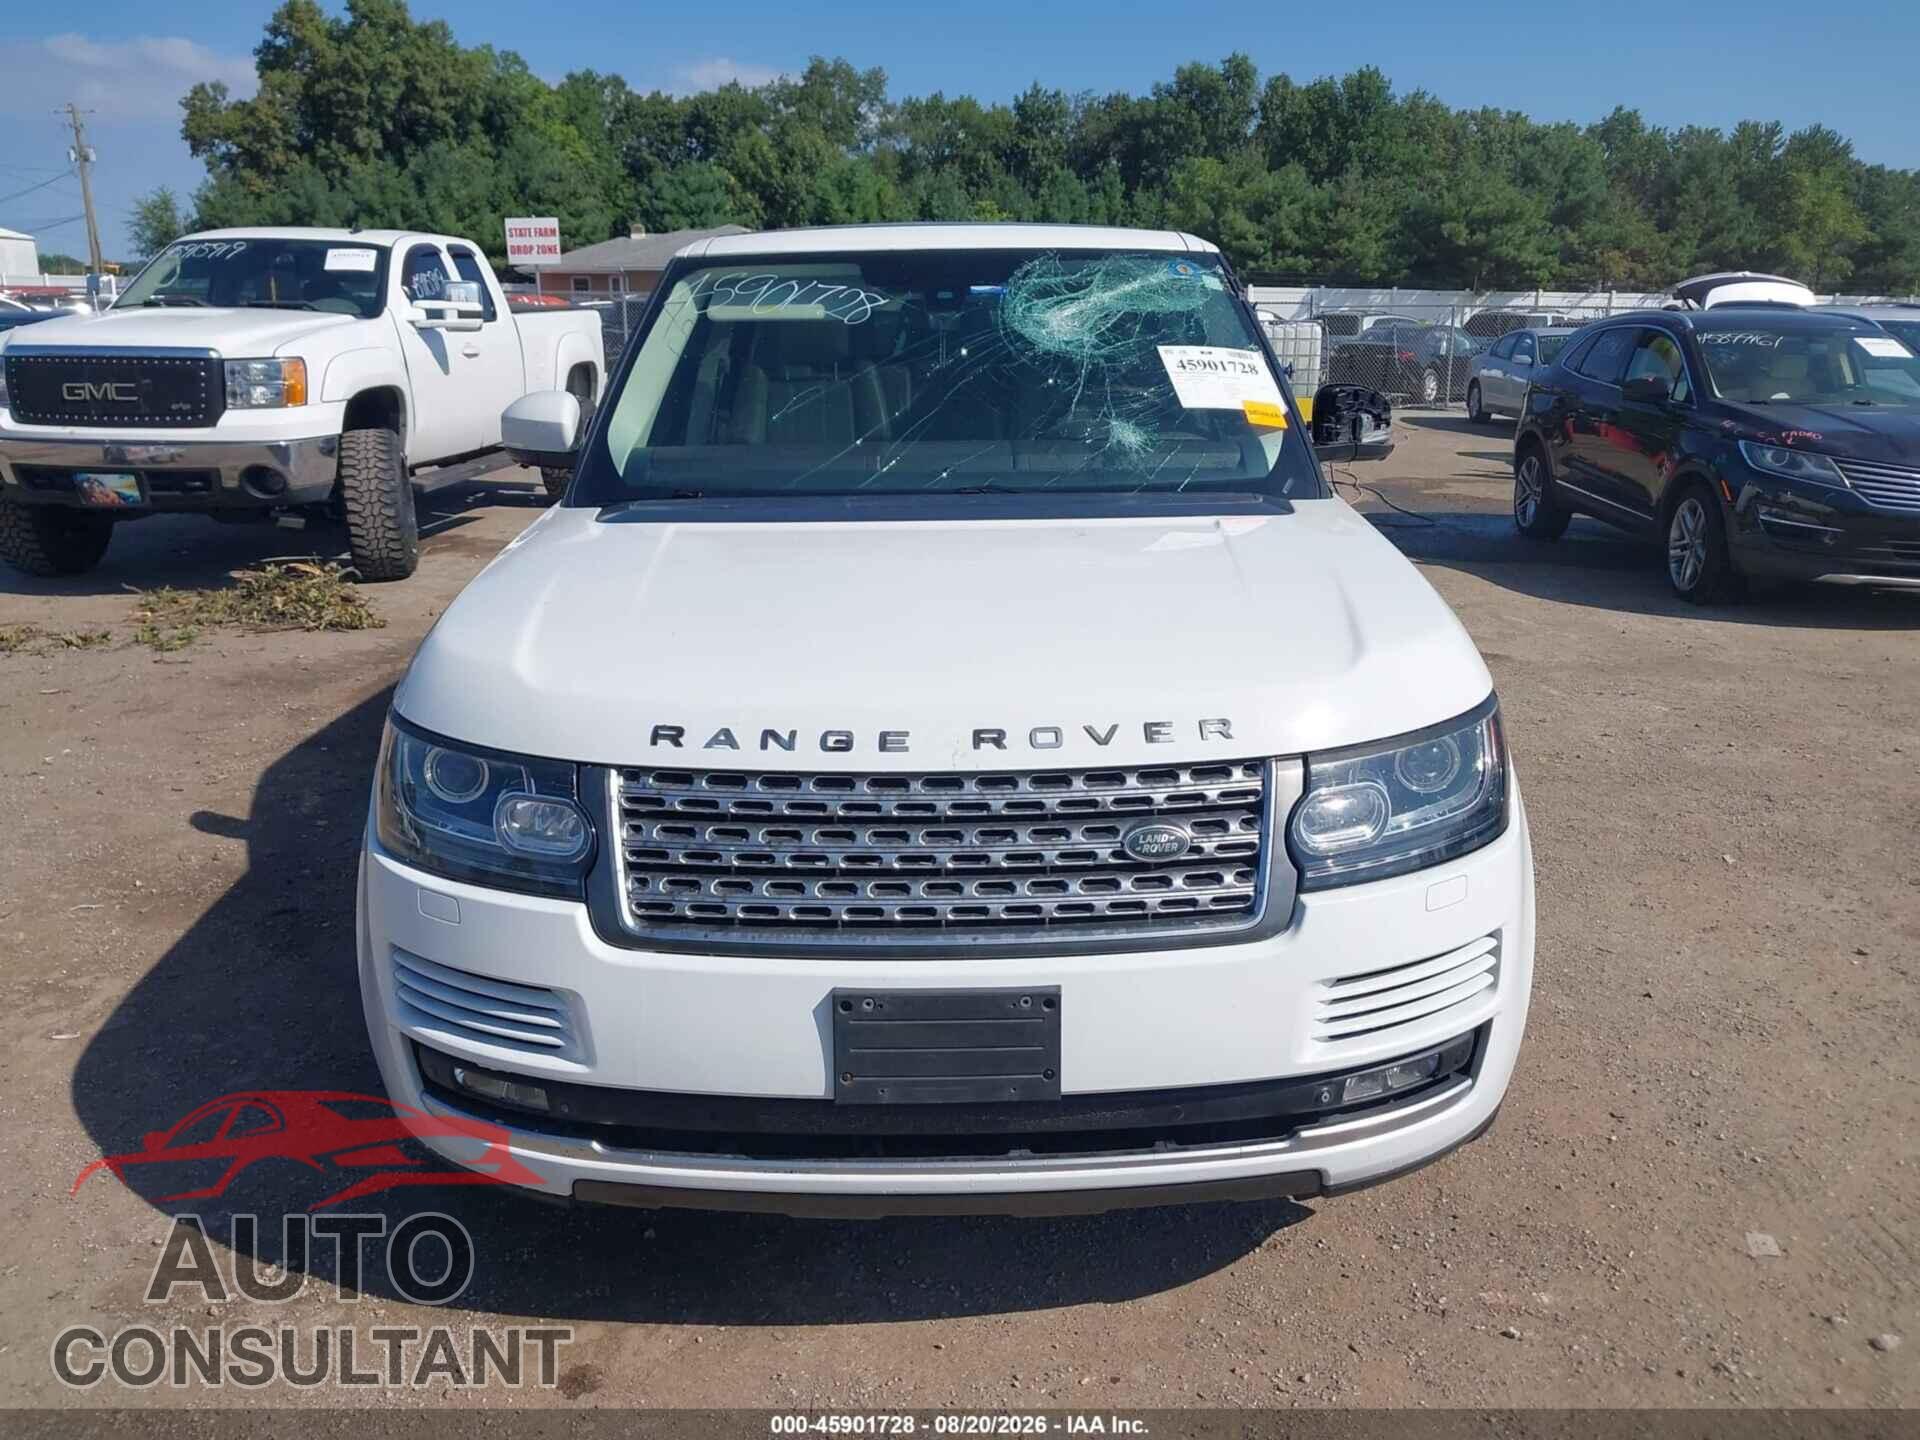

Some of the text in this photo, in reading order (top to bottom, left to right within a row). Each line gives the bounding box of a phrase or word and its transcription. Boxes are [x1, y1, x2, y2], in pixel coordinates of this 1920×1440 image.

[508, 227, 557, 237] STATE FARM
[510, 244, 558, 255] DROP ZONE
[1176, 358, 1259, 376] 45901728
[62, 382, 139, 401] GMC
[649, 717, 1236, 753] RANGE ROVER
